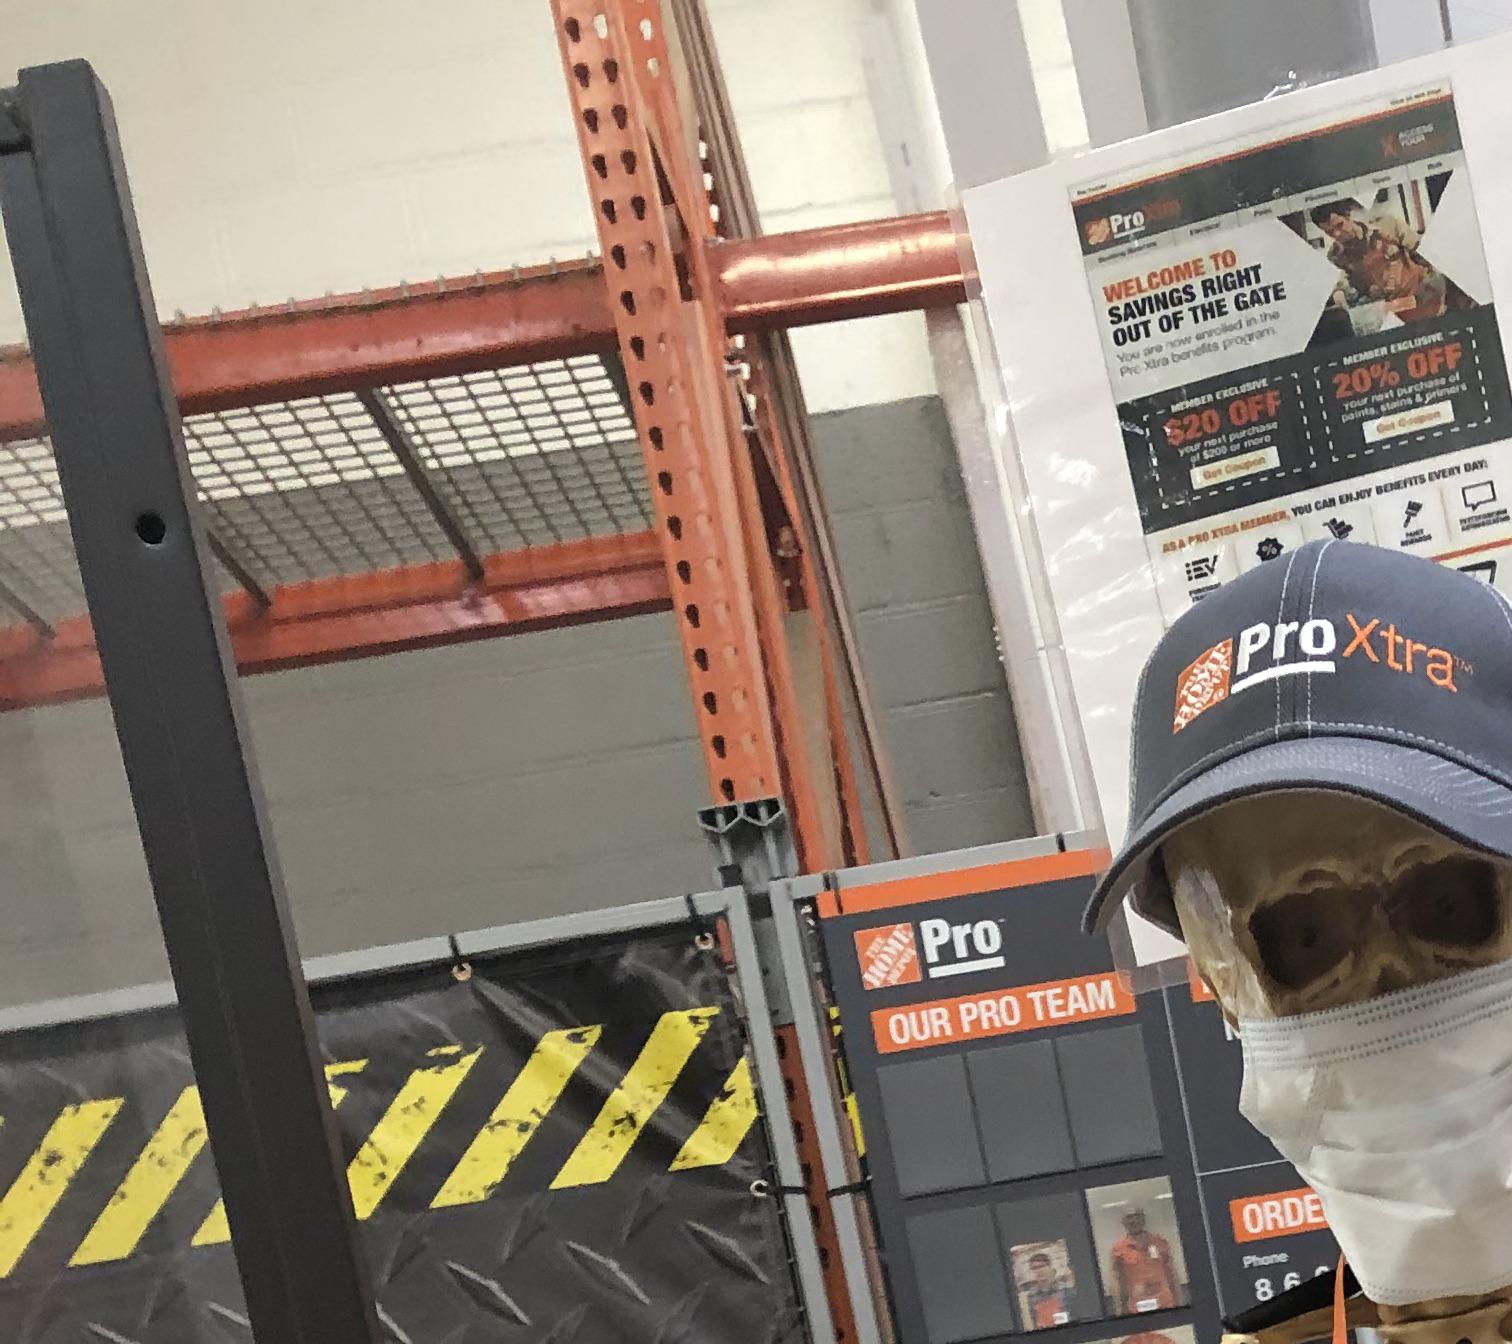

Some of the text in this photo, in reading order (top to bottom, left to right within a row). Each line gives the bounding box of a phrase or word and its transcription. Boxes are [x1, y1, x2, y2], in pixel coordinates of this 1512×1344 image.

[1110, 211, 1144, 233] Pro
[1103, 249, 1237, 302] WELCOME TO
[1108, 264, 1262, 325] SAVINGS RIGHT
[1113, 281, 1287, 347] OUT OF THE GATE
[1333, 342, 1463, 399] 20% OFF
[1343, 332, 1444, 366] MEMBER EXCLUSIVE
[1163, 389, 1281, 446] $20 OFF
[1171, 378, 1268, 413] MEMBER EXCLUSIVE
[1236, 617, 1337, 675] Pro
[862, 923, 915, 987] HOME
[920, 918, 1002, 963] Pro
[888, 979, 1116, 1045] OUR PRO TEAM
[1242, 1193, 1326, 1234] ORDE
[1242, 1252, 1289, 1269] Phone
